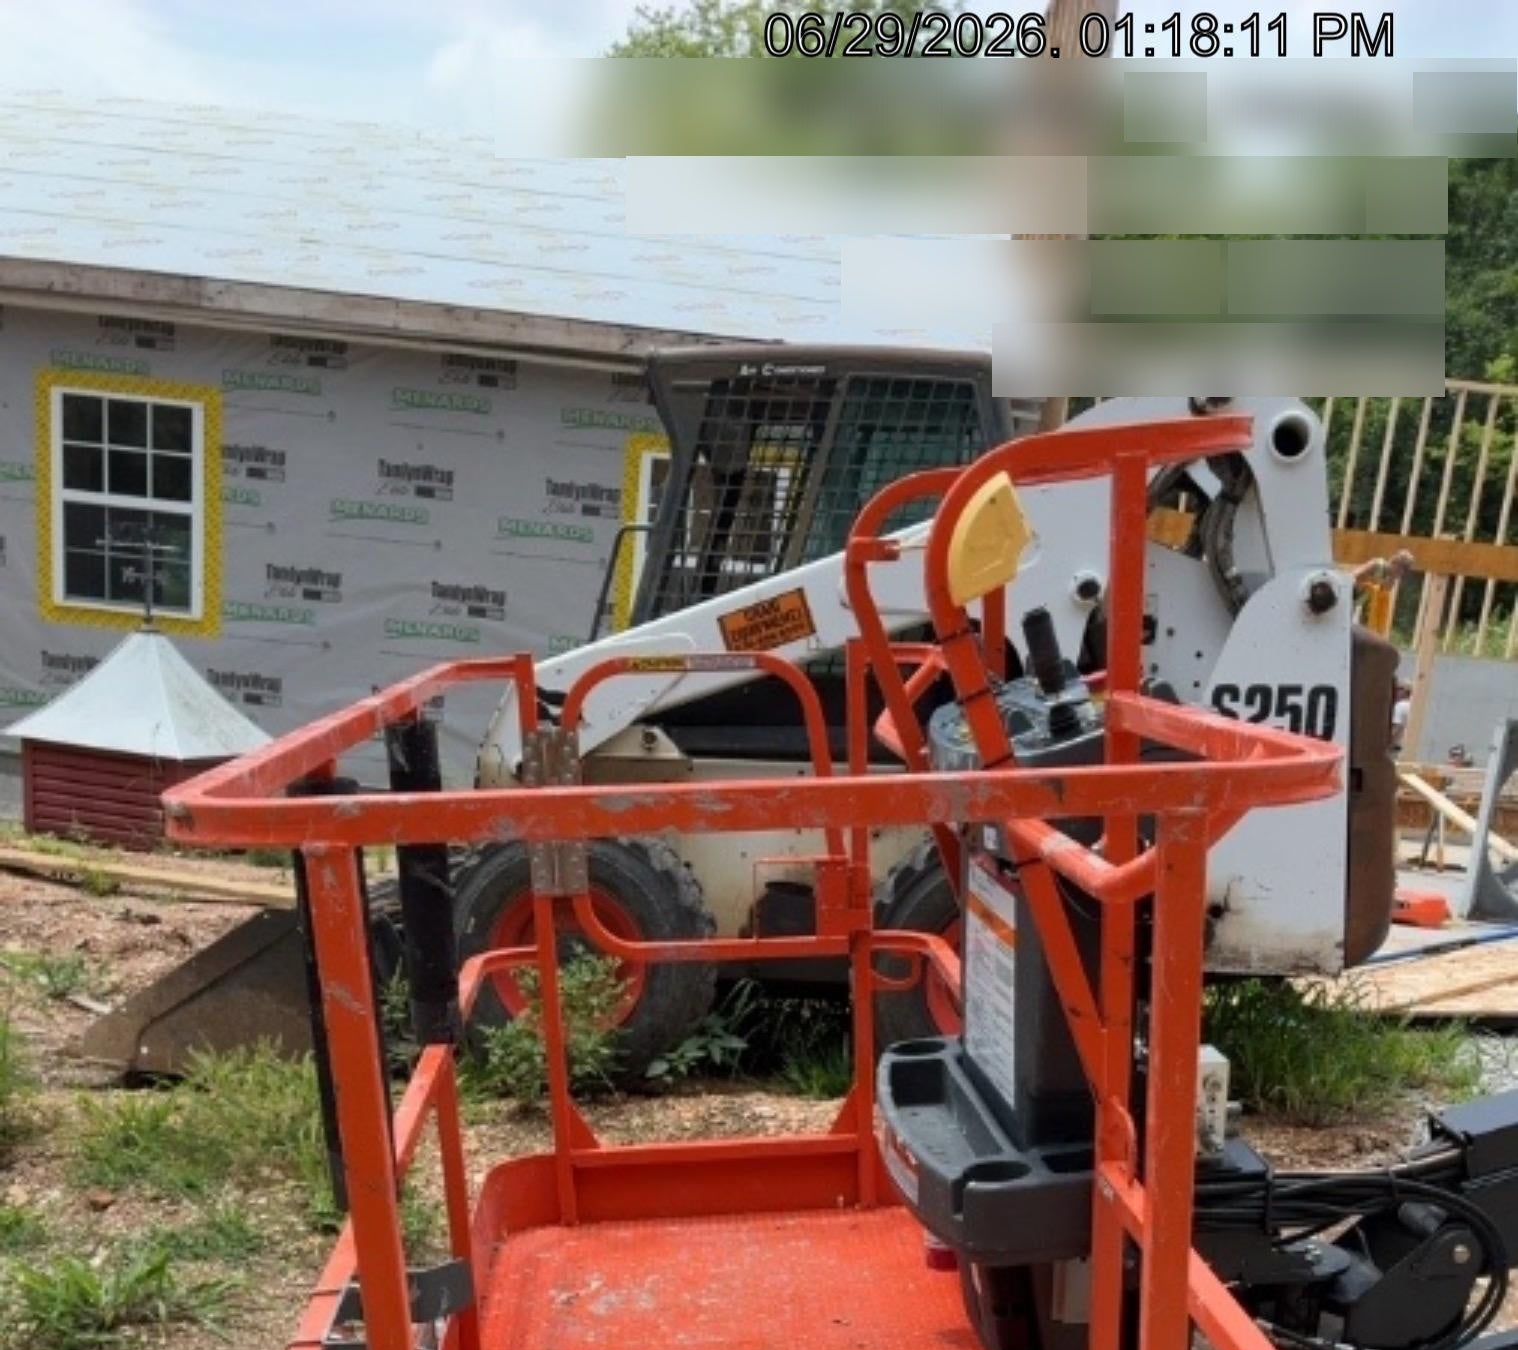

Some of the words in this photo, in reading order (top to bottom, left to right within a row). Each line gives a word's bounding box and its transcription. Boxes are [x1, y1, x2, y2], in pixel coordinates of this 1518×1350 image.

[392, 387, 491, 415] MENARDS
[330, 498, 430, 526] MENARDS
[498, 517, 594, 543] MENARDS
[1211, 683, 1339, 742] S250
